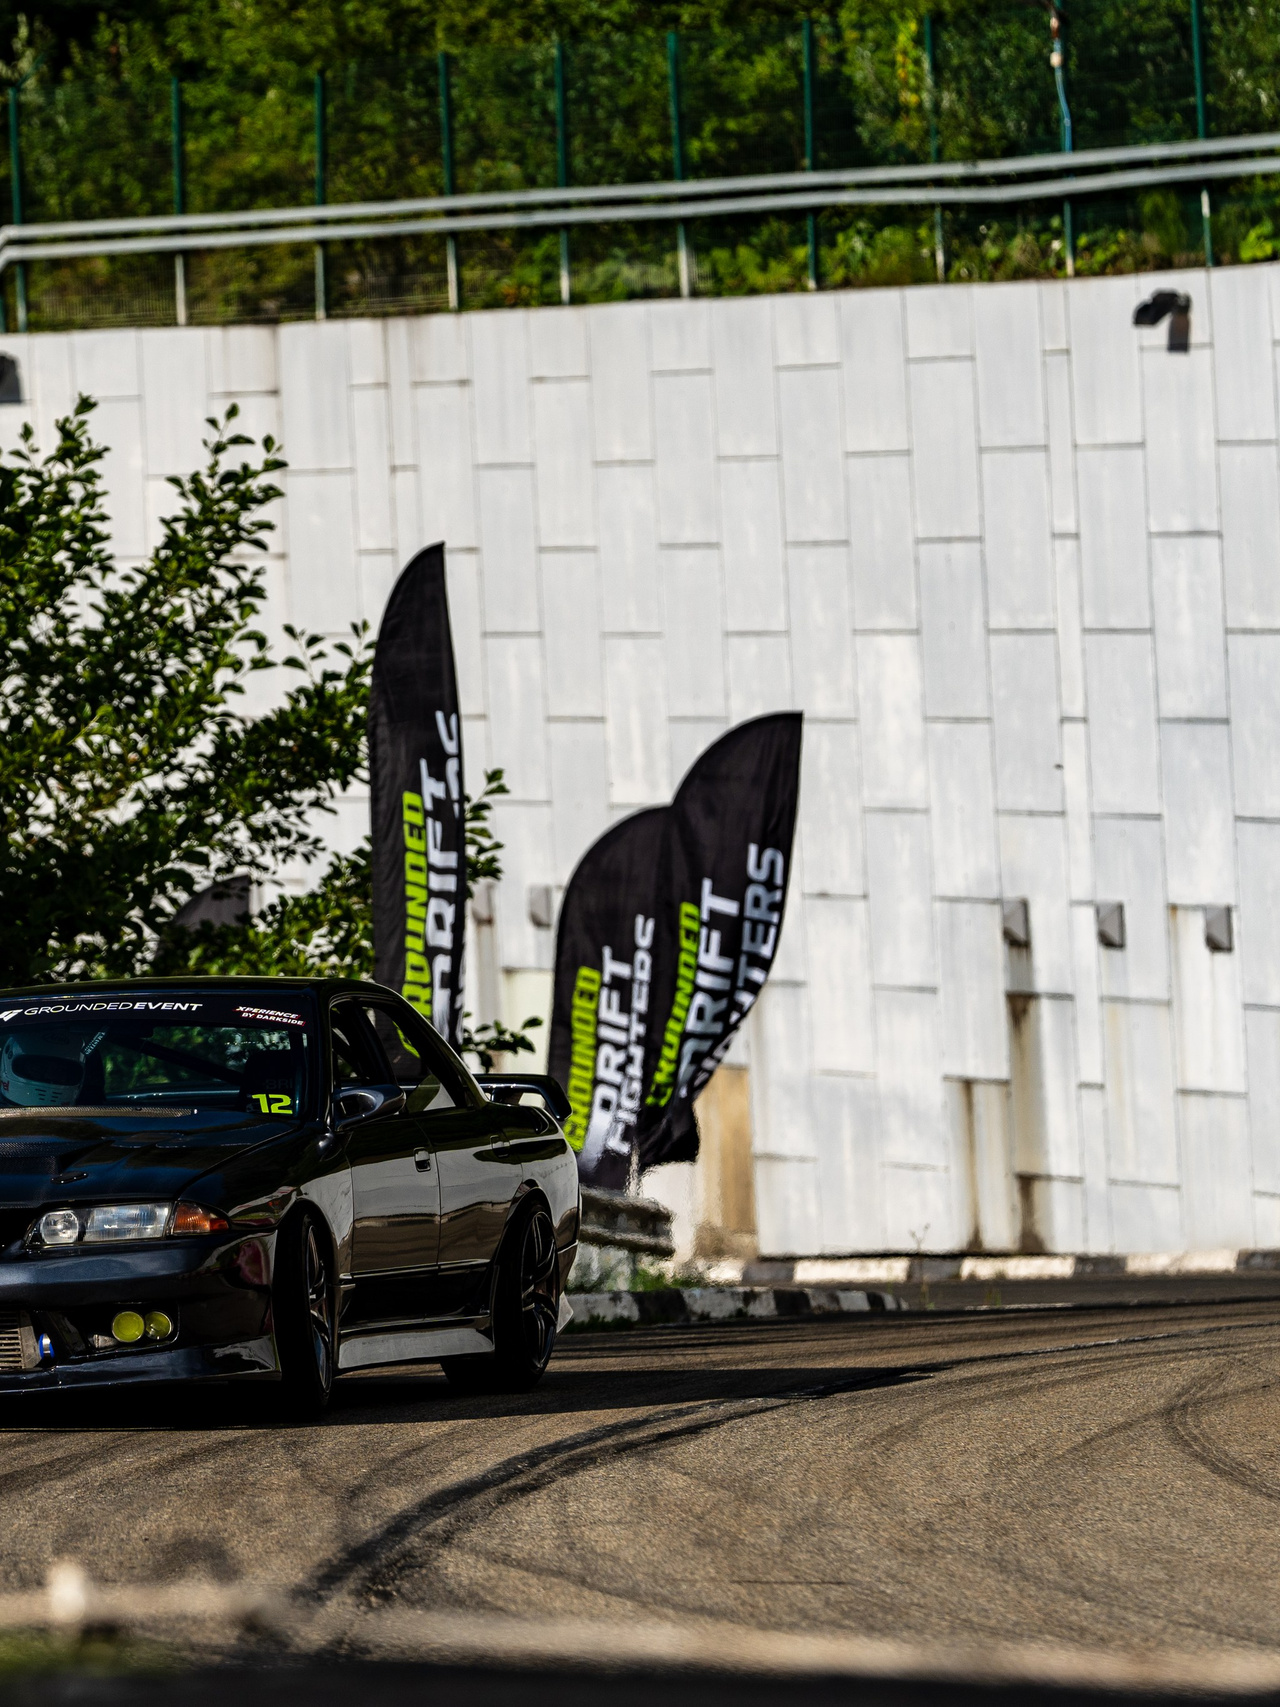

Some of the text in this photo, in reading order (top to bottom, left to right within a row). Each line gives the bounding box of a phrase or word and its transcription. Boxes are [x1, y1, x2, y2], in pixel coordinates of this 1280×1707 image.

[235, 1005, 299, 1019] XPERIENCE
[255, 1013, 305, 1026] DARKSIDE
[583, 945, 633, 1155] DRIFT
[251, 1093, 294, 1115] 12
